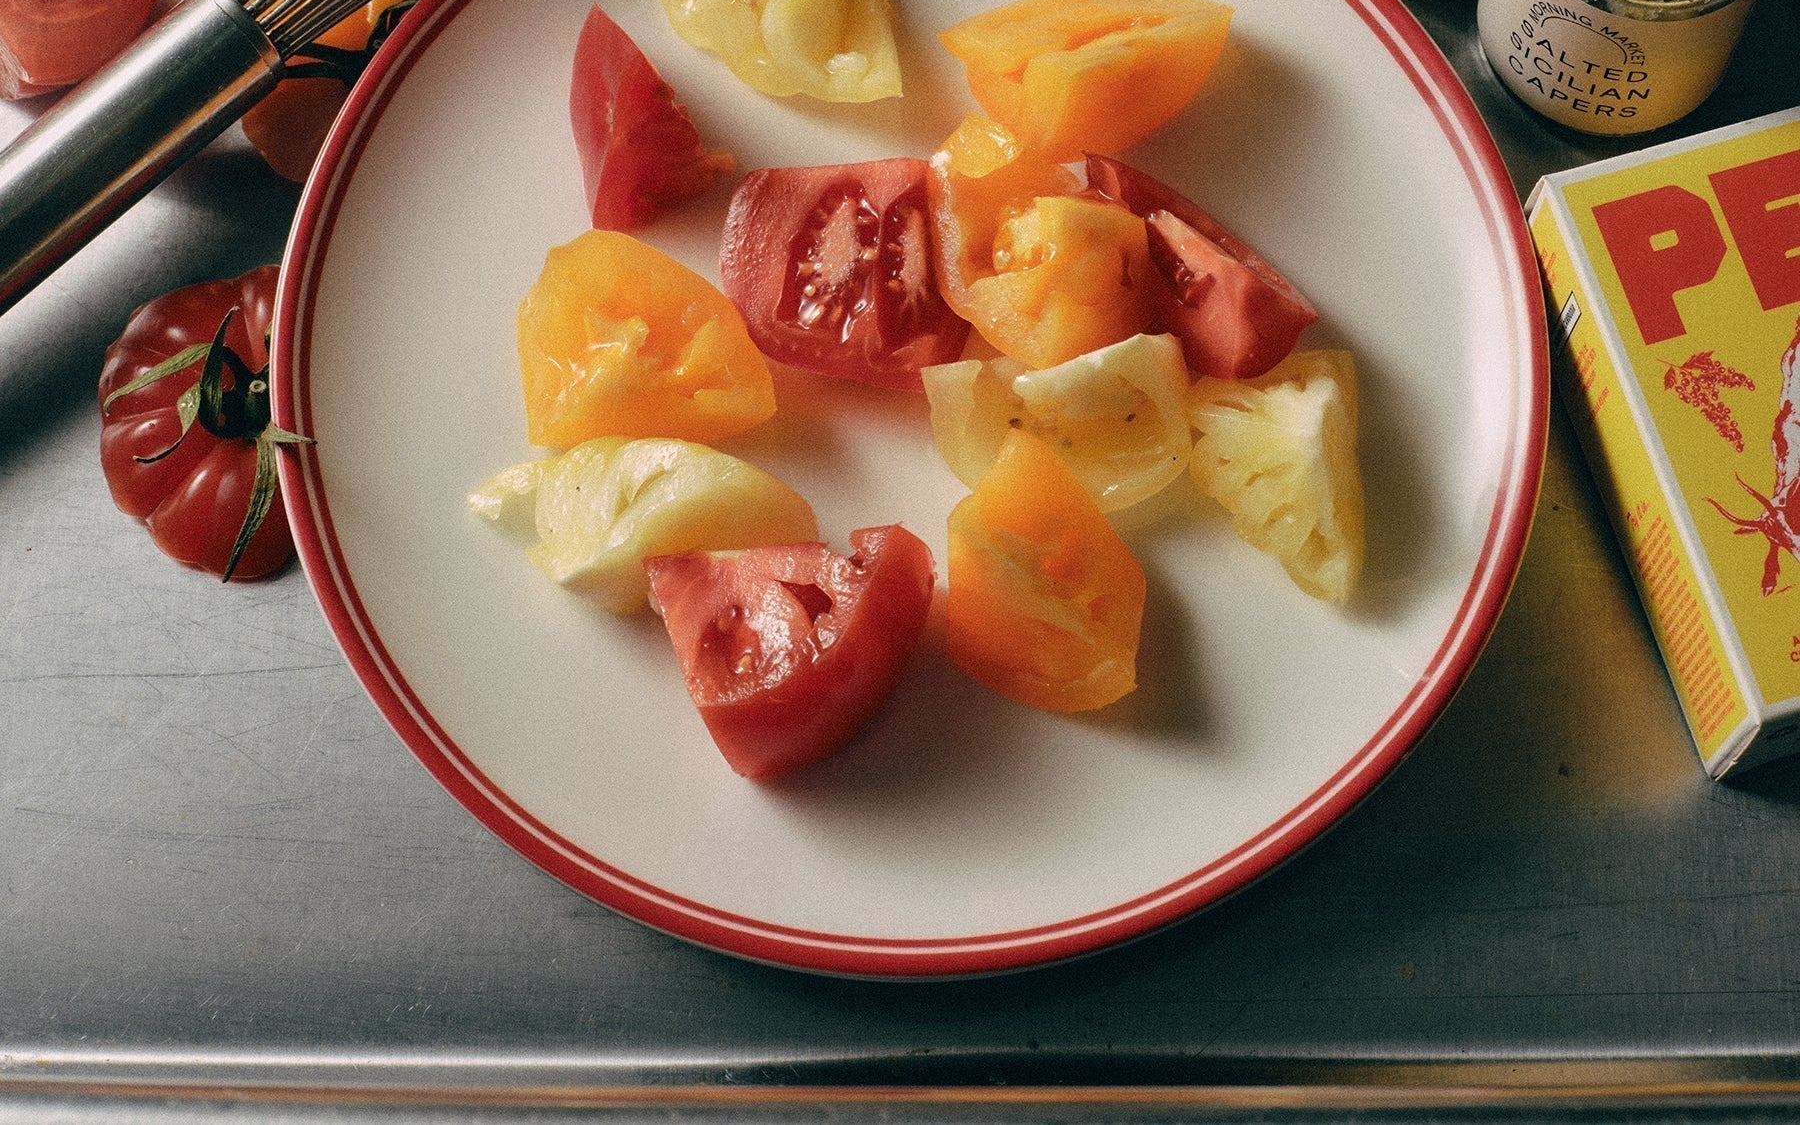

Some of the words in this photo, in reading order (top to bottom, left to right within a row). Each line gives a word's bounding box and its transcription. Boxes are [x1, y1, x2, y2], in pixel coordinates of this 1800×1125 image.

[1510, 31, 1651, 100] SICILIAN
[1520, 19, 1648, 83] SALTED
[1528, 1, 1593, 27] MORNING
[1600, 26, 1646, 66] MARKET
[1508, 54, 1637, 118] CAPERS
